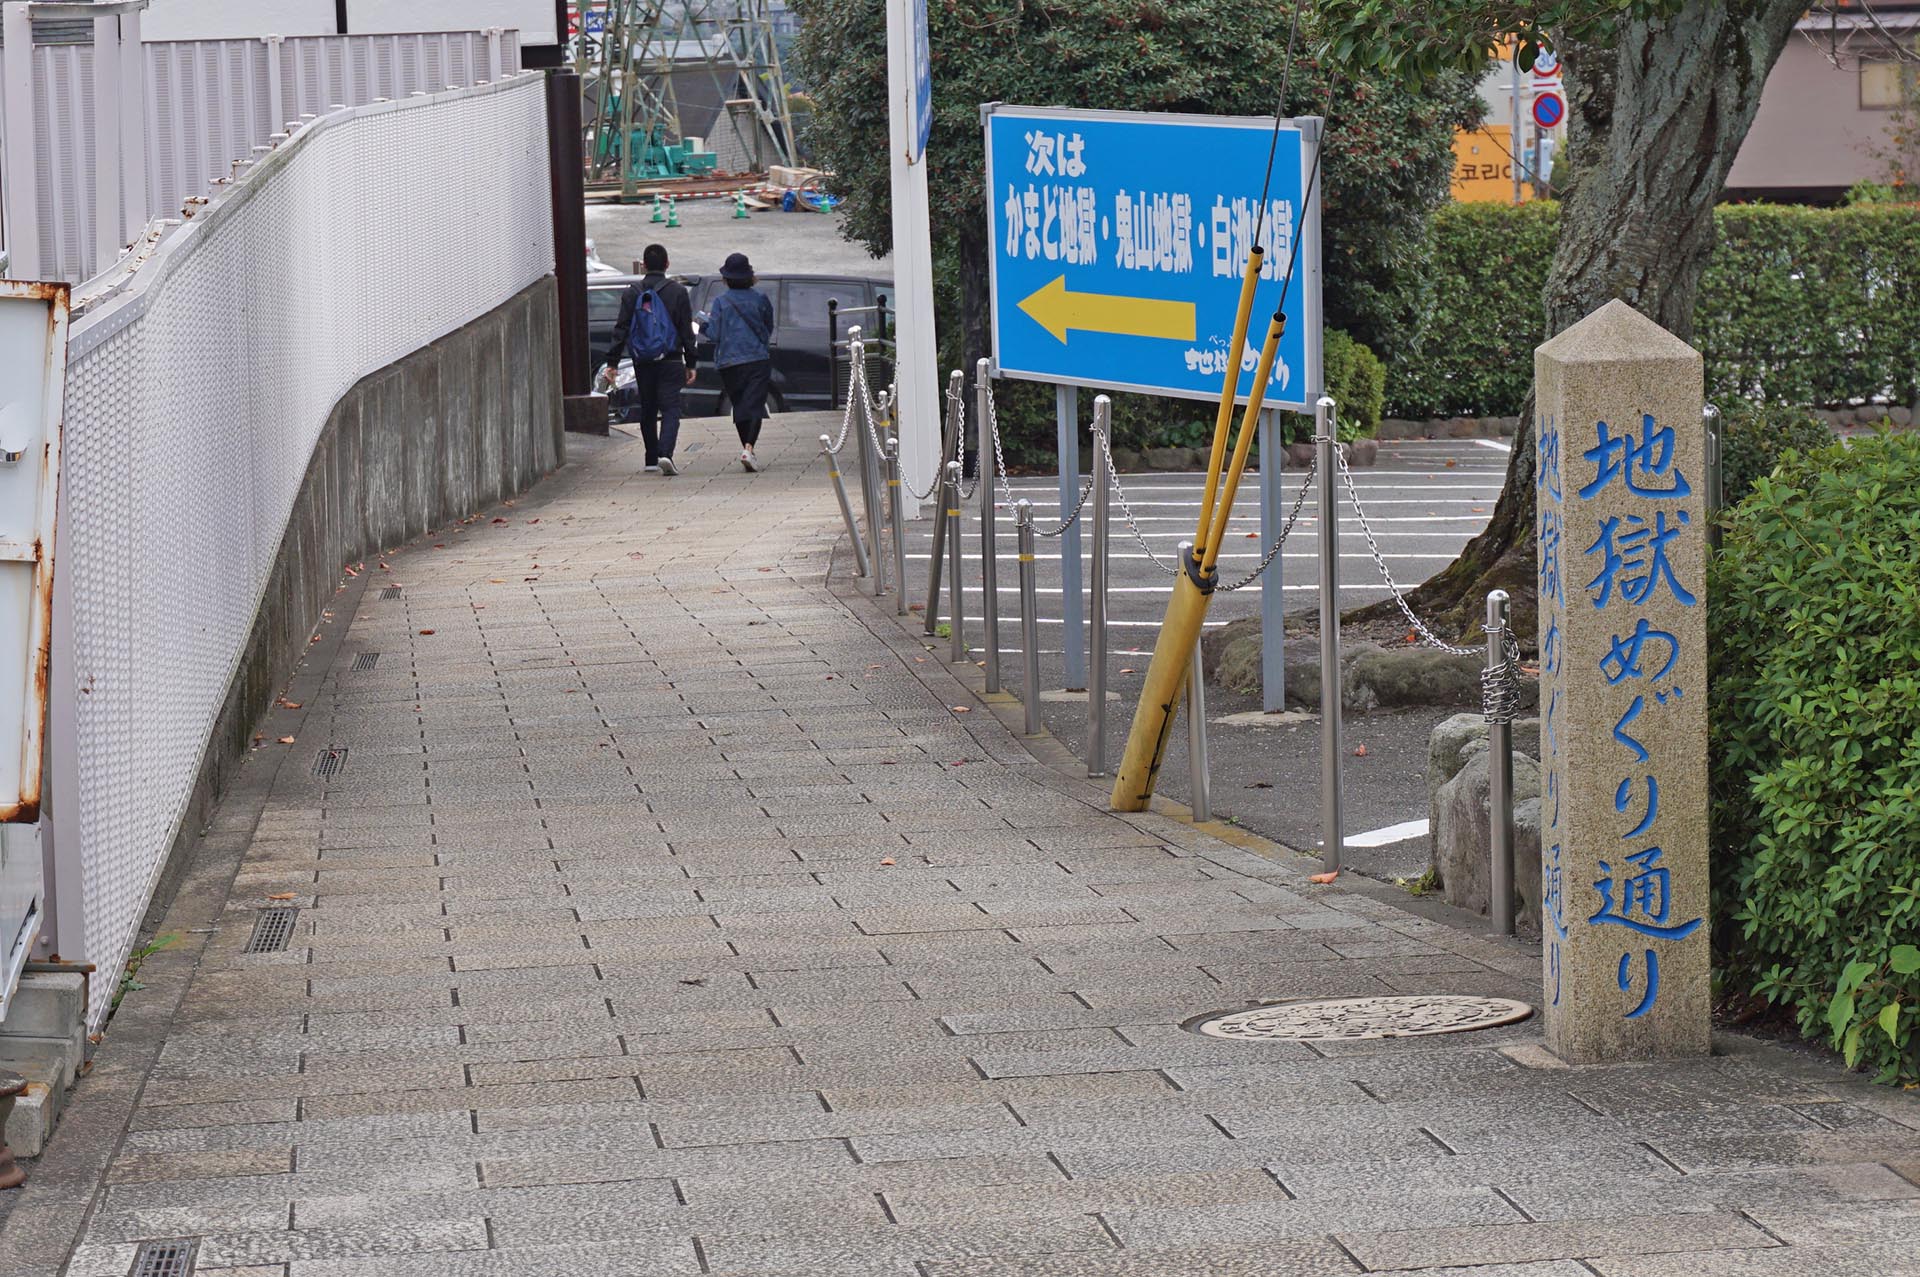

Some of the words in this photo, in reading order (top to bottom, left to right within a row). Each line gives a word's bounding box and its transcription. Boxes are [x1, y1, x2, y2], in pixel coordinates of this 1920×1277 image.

[1025, 130, 1087, 178] 次は
[1537, 413, 1568, 1006] 地獄めぐり通り
[1578, 413, 1702, 1018] 地獄めぐり通り
